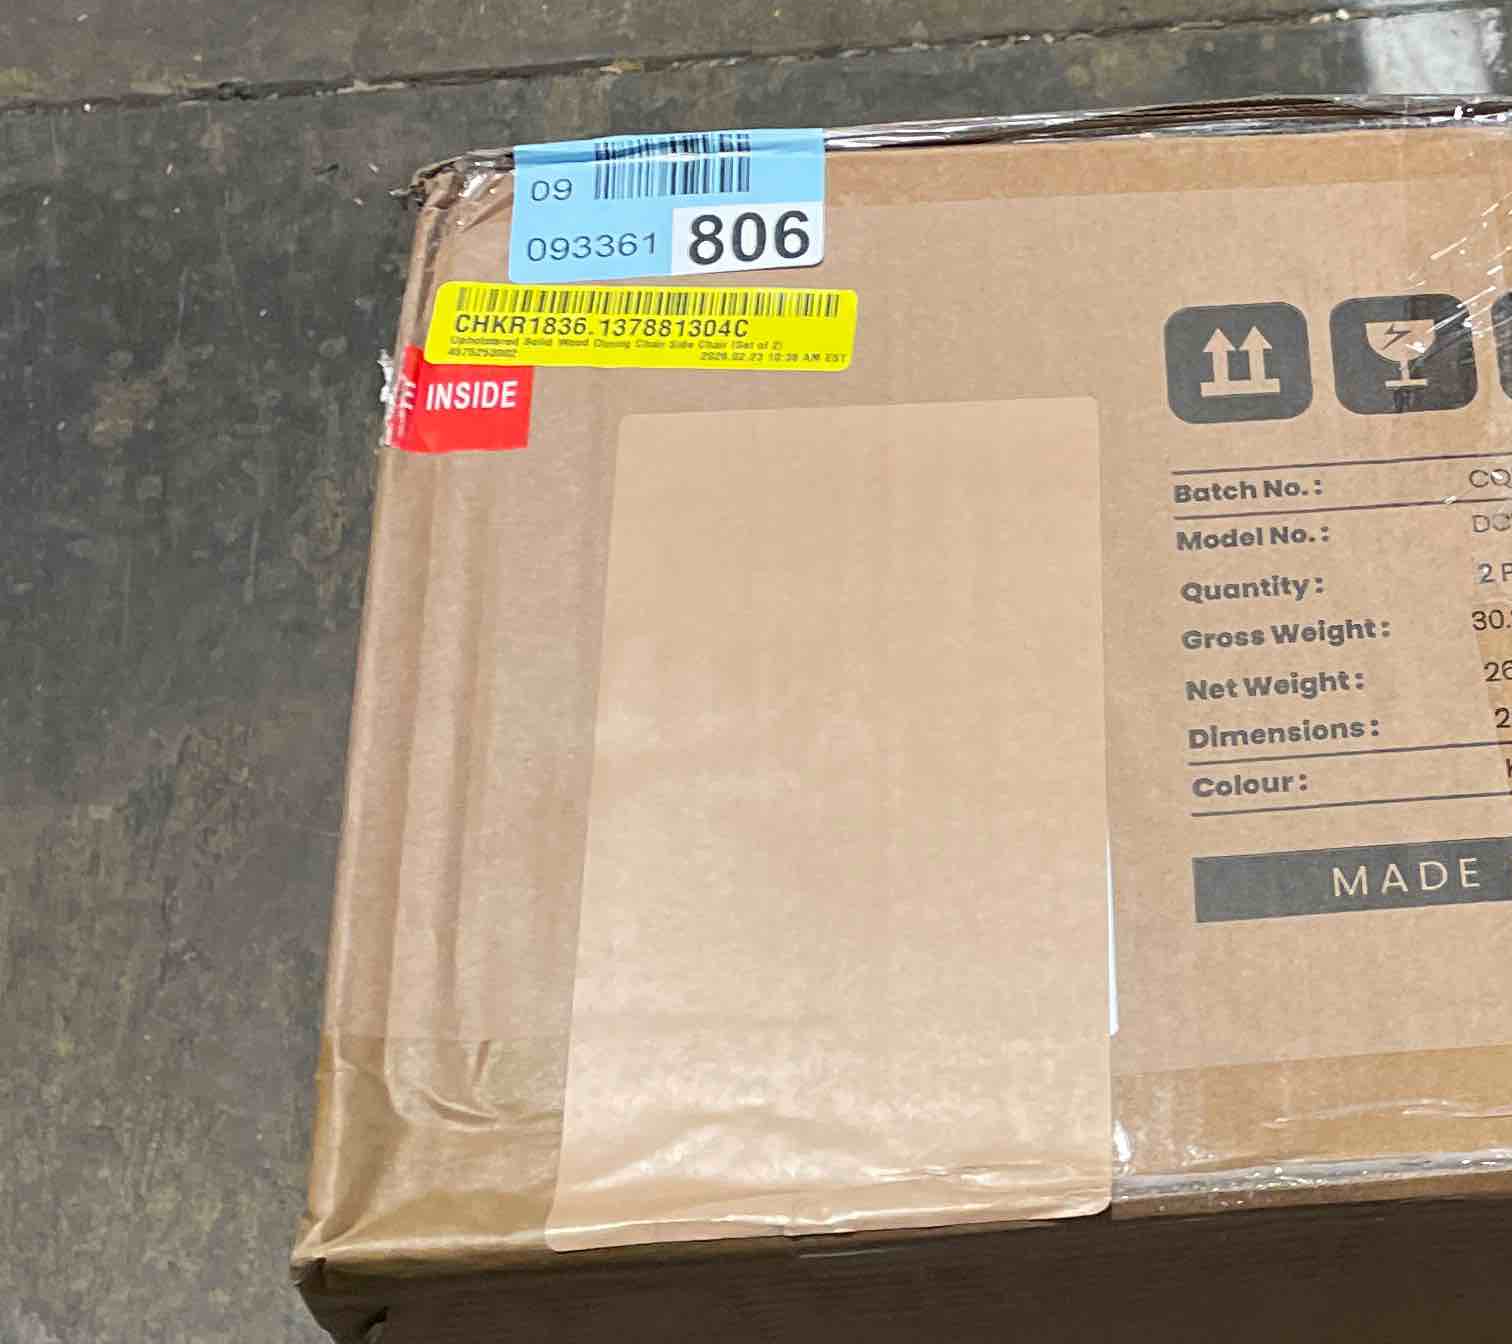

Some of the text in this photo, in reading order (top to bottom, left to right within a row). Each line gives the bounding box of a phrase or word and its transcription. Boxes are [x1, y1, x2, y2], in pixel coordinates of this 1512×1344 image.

[530, 178, 574, 203] 09
[526, 232, 657, 262] 093361
[688, 209, 810, 266] 806
[425, 379, 519, 412] INSIDE
[1173, 480, 1258, 504] Batch
[1175, 526, 1264, 552] Model
[1477, 564, 1495, 584] 2
[1181, 628, 1265, 651] Gross
[1185, 677, 1239, 702] Net
[1331, 855, 1482, 899] MADE
